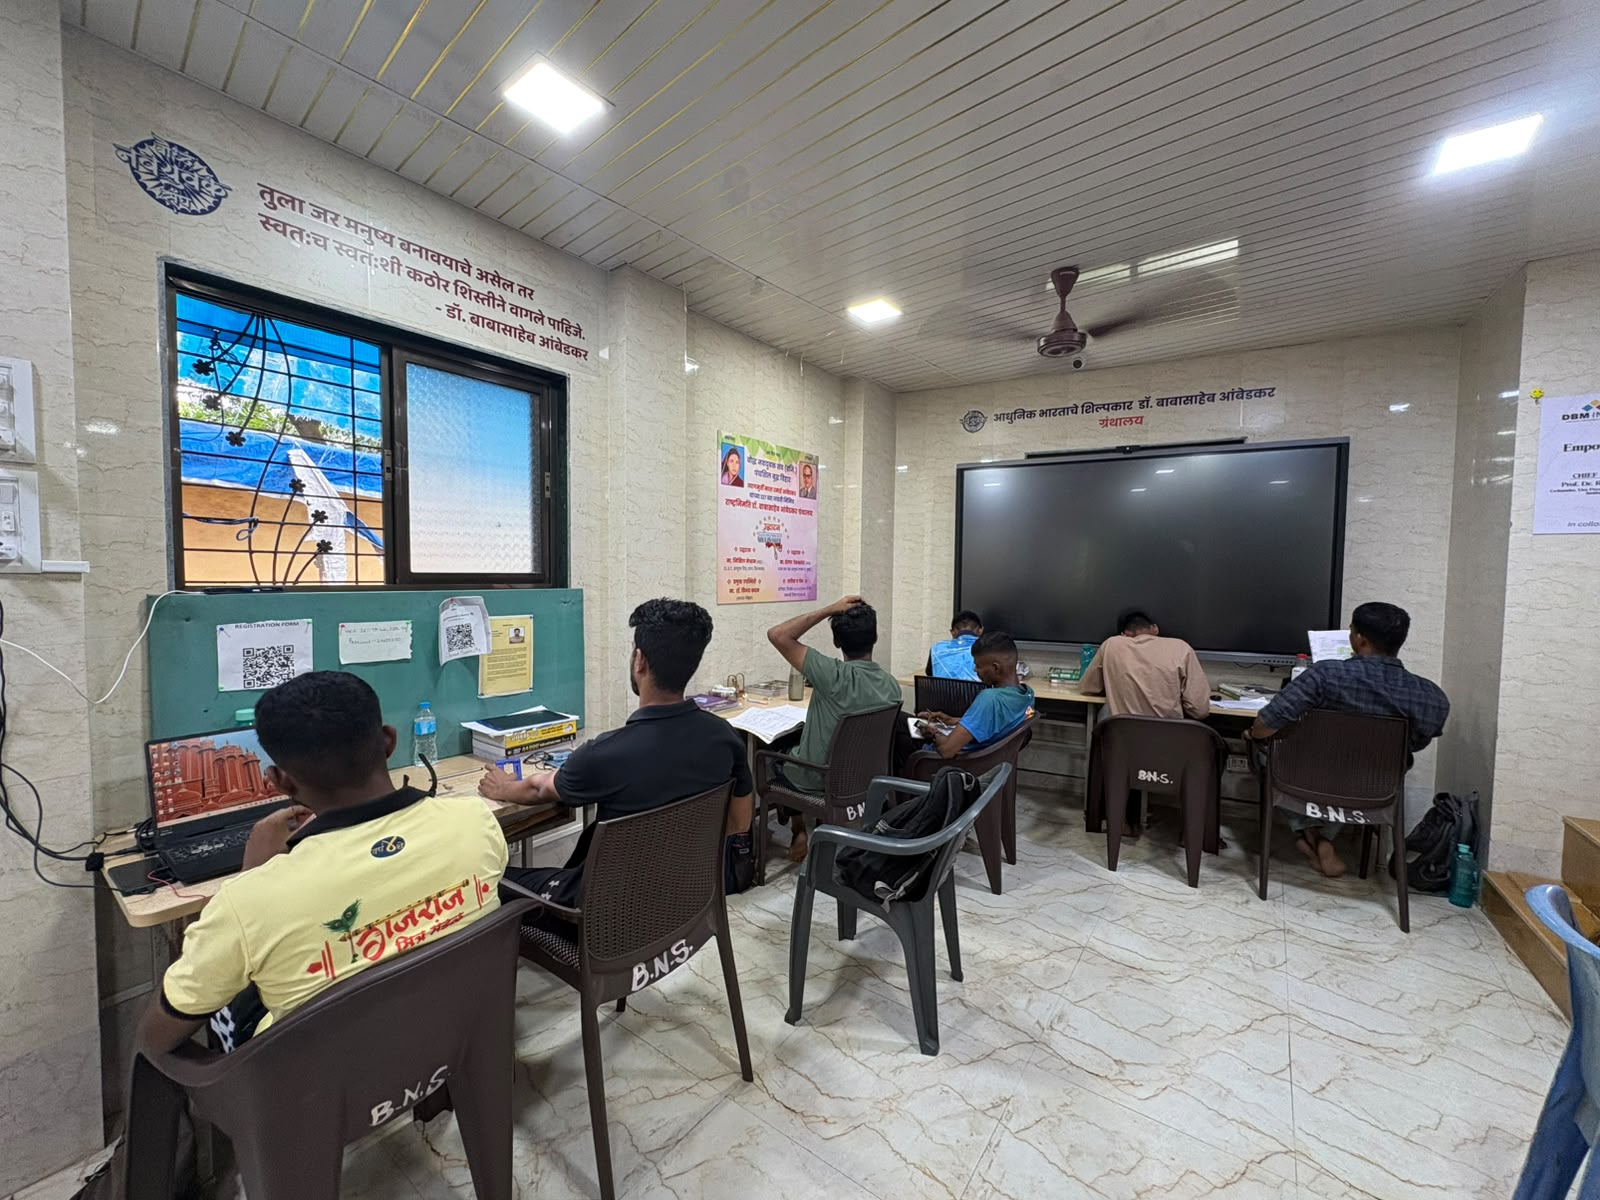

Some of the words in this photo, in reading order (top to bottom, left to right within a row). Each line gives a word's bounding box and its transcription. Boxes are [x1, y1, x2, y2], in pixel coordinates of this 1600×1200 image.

[257, 182, 306, 214] तुला
[309, 202, 341, 227] जर
[344, 215, 395, 248] मनुष्य
[398, 237, 472, 277] बनावयाचे
[476, 268, 514, 293] असेल
[517, 283, 535, 301] तर
[406, 265, 450, 293] कठोर
[453, 279, 506, 313] शिस्तीने
[509, 302, 545, 326] वागले
[548, 317, 586, 340] पाहिजे.
[445, 303, 466, 323] डॉ.
[469, 312, 536, 345] बाबासाहेब
[539, 335, 589, 361] आंबेडकर
[993, 408, 1037, 424] आधुनिक
[1039, 403, 1079, 418] भारताचे
[1081, 401, 1133, 415] शिल्पकार
[1138, 396, 1153, 409] डॉ.
[1156, 392, 1216, 407] बाबासाहेब
[1219, 387, 1276, 402] आंबेडकर
[1099, 415, 1144, 429] ग्रंथालय
[1562, 412, 1590, 421] DBM
